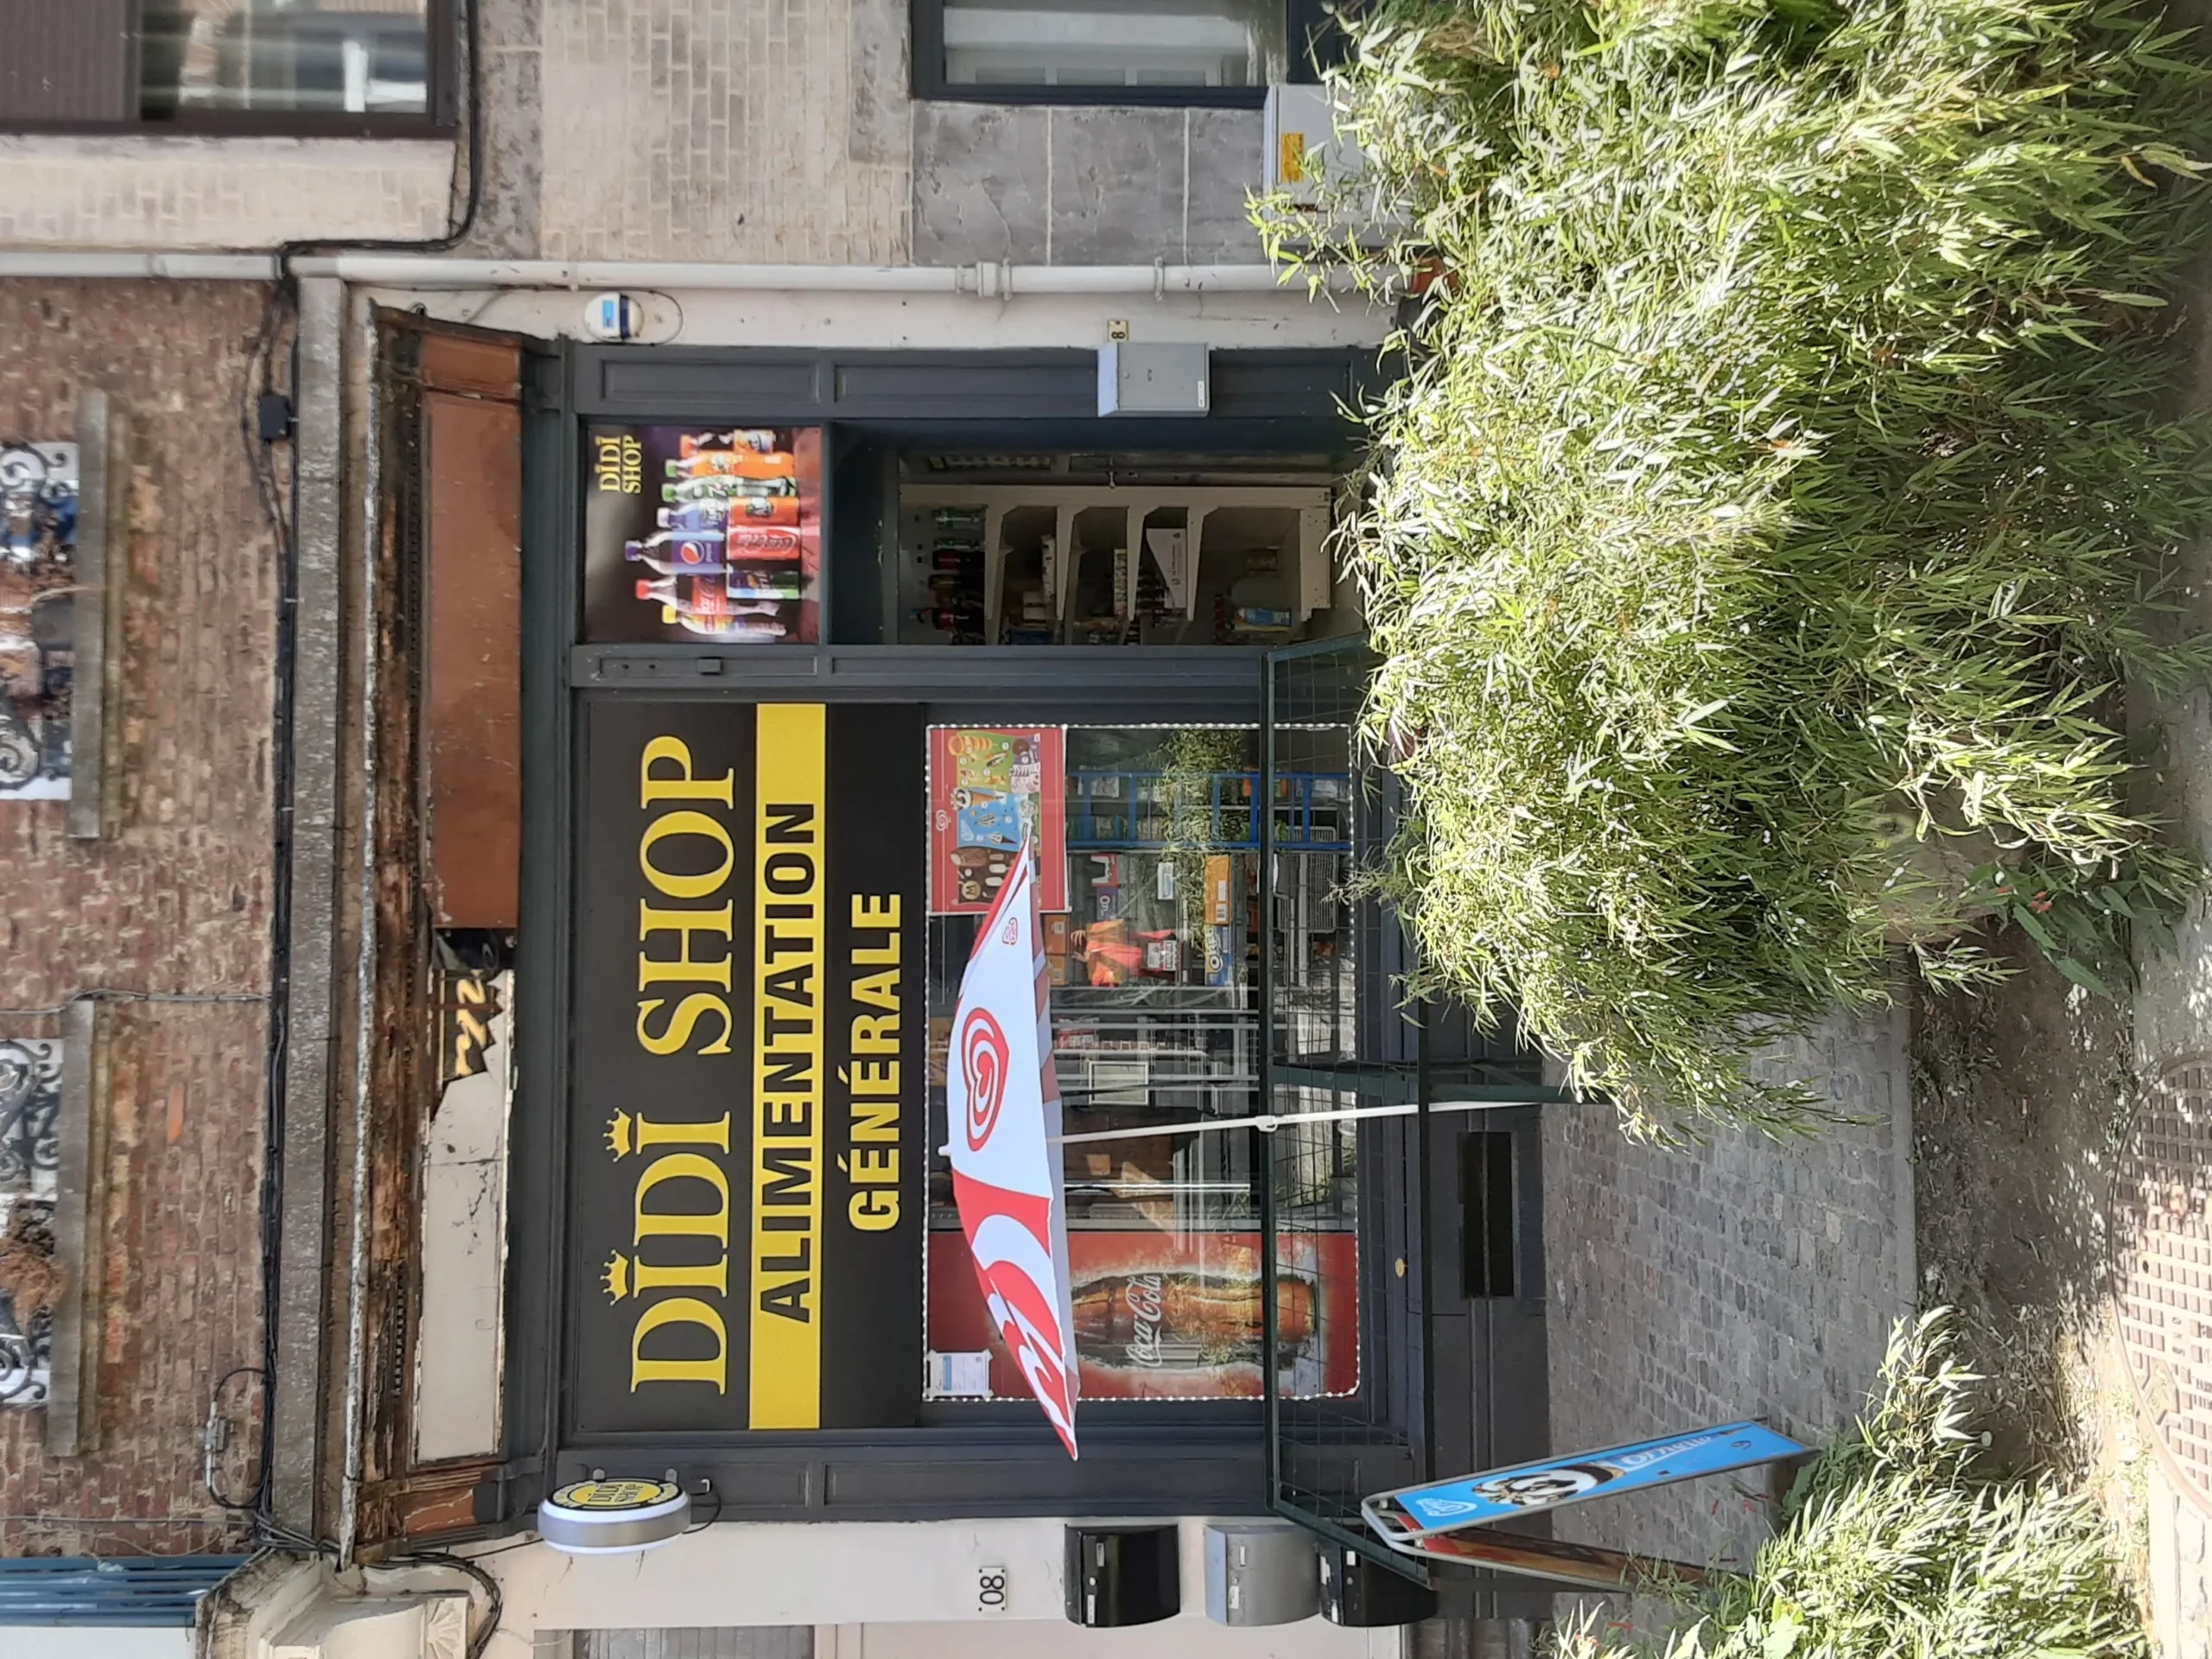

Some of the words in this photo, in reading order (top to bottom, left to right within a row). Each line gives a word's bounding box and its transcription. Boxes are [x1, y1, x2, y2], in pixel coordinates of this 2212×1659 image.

[596, 435, 621, 491] DIDI
[622, 435, 643, 493] SHOP
[636, 734, 734, 1055] SHOP
[1205, 925, 1224, 971] OREO
[760, 803, 815, 1324] ALIMENTATION
[837, 893, 901, 1231] GÉNÉRALE
[629, 1110, 731, 1395] DIDI
[1125, 1274, 1162, 1367] Coca-Cola
[979, 1574, 1005, 1605] 08
